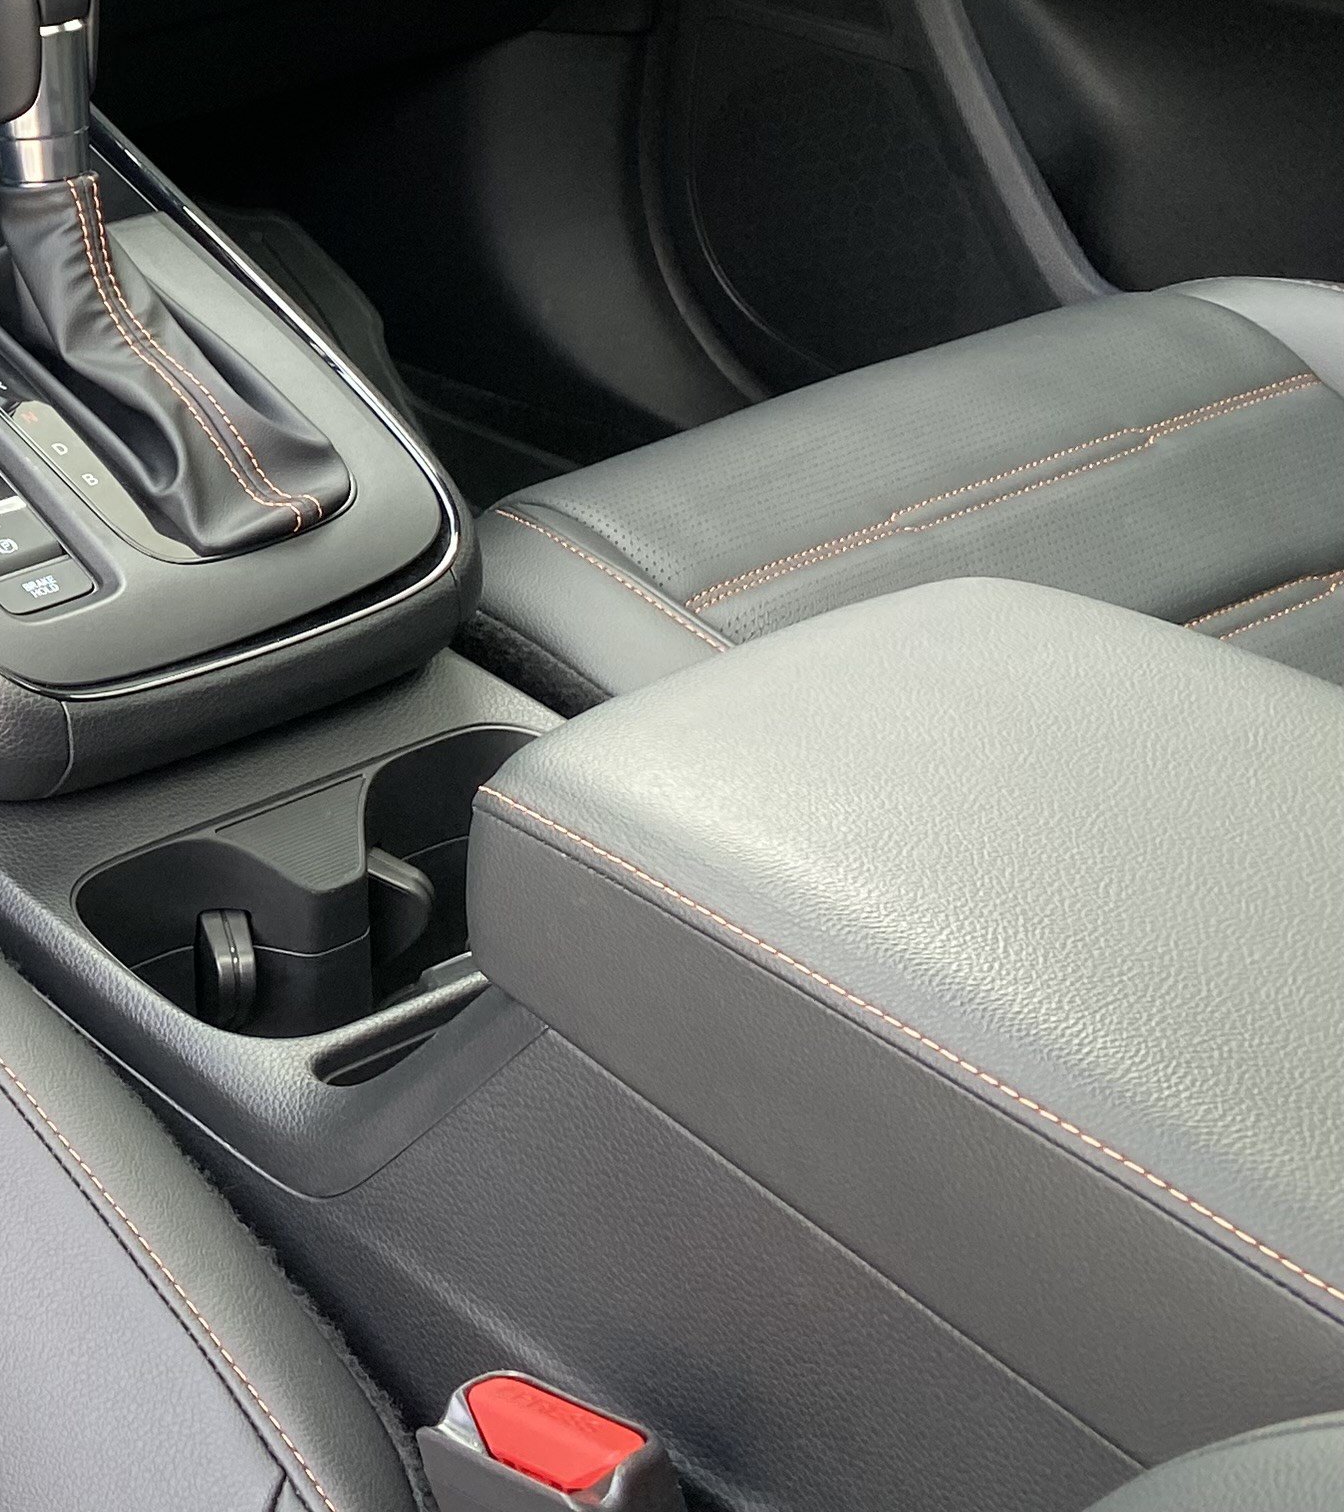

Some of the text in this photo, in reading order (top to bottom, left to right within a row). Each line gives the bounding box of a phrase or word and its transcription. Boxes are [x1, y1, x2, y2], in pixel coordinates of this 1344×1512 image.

[51, 442, 69, 456] D
[81, 473, 99, 486] B
[21, 574, 57, 592] BRAKE
[29, 583, 60, 599] HOLD
